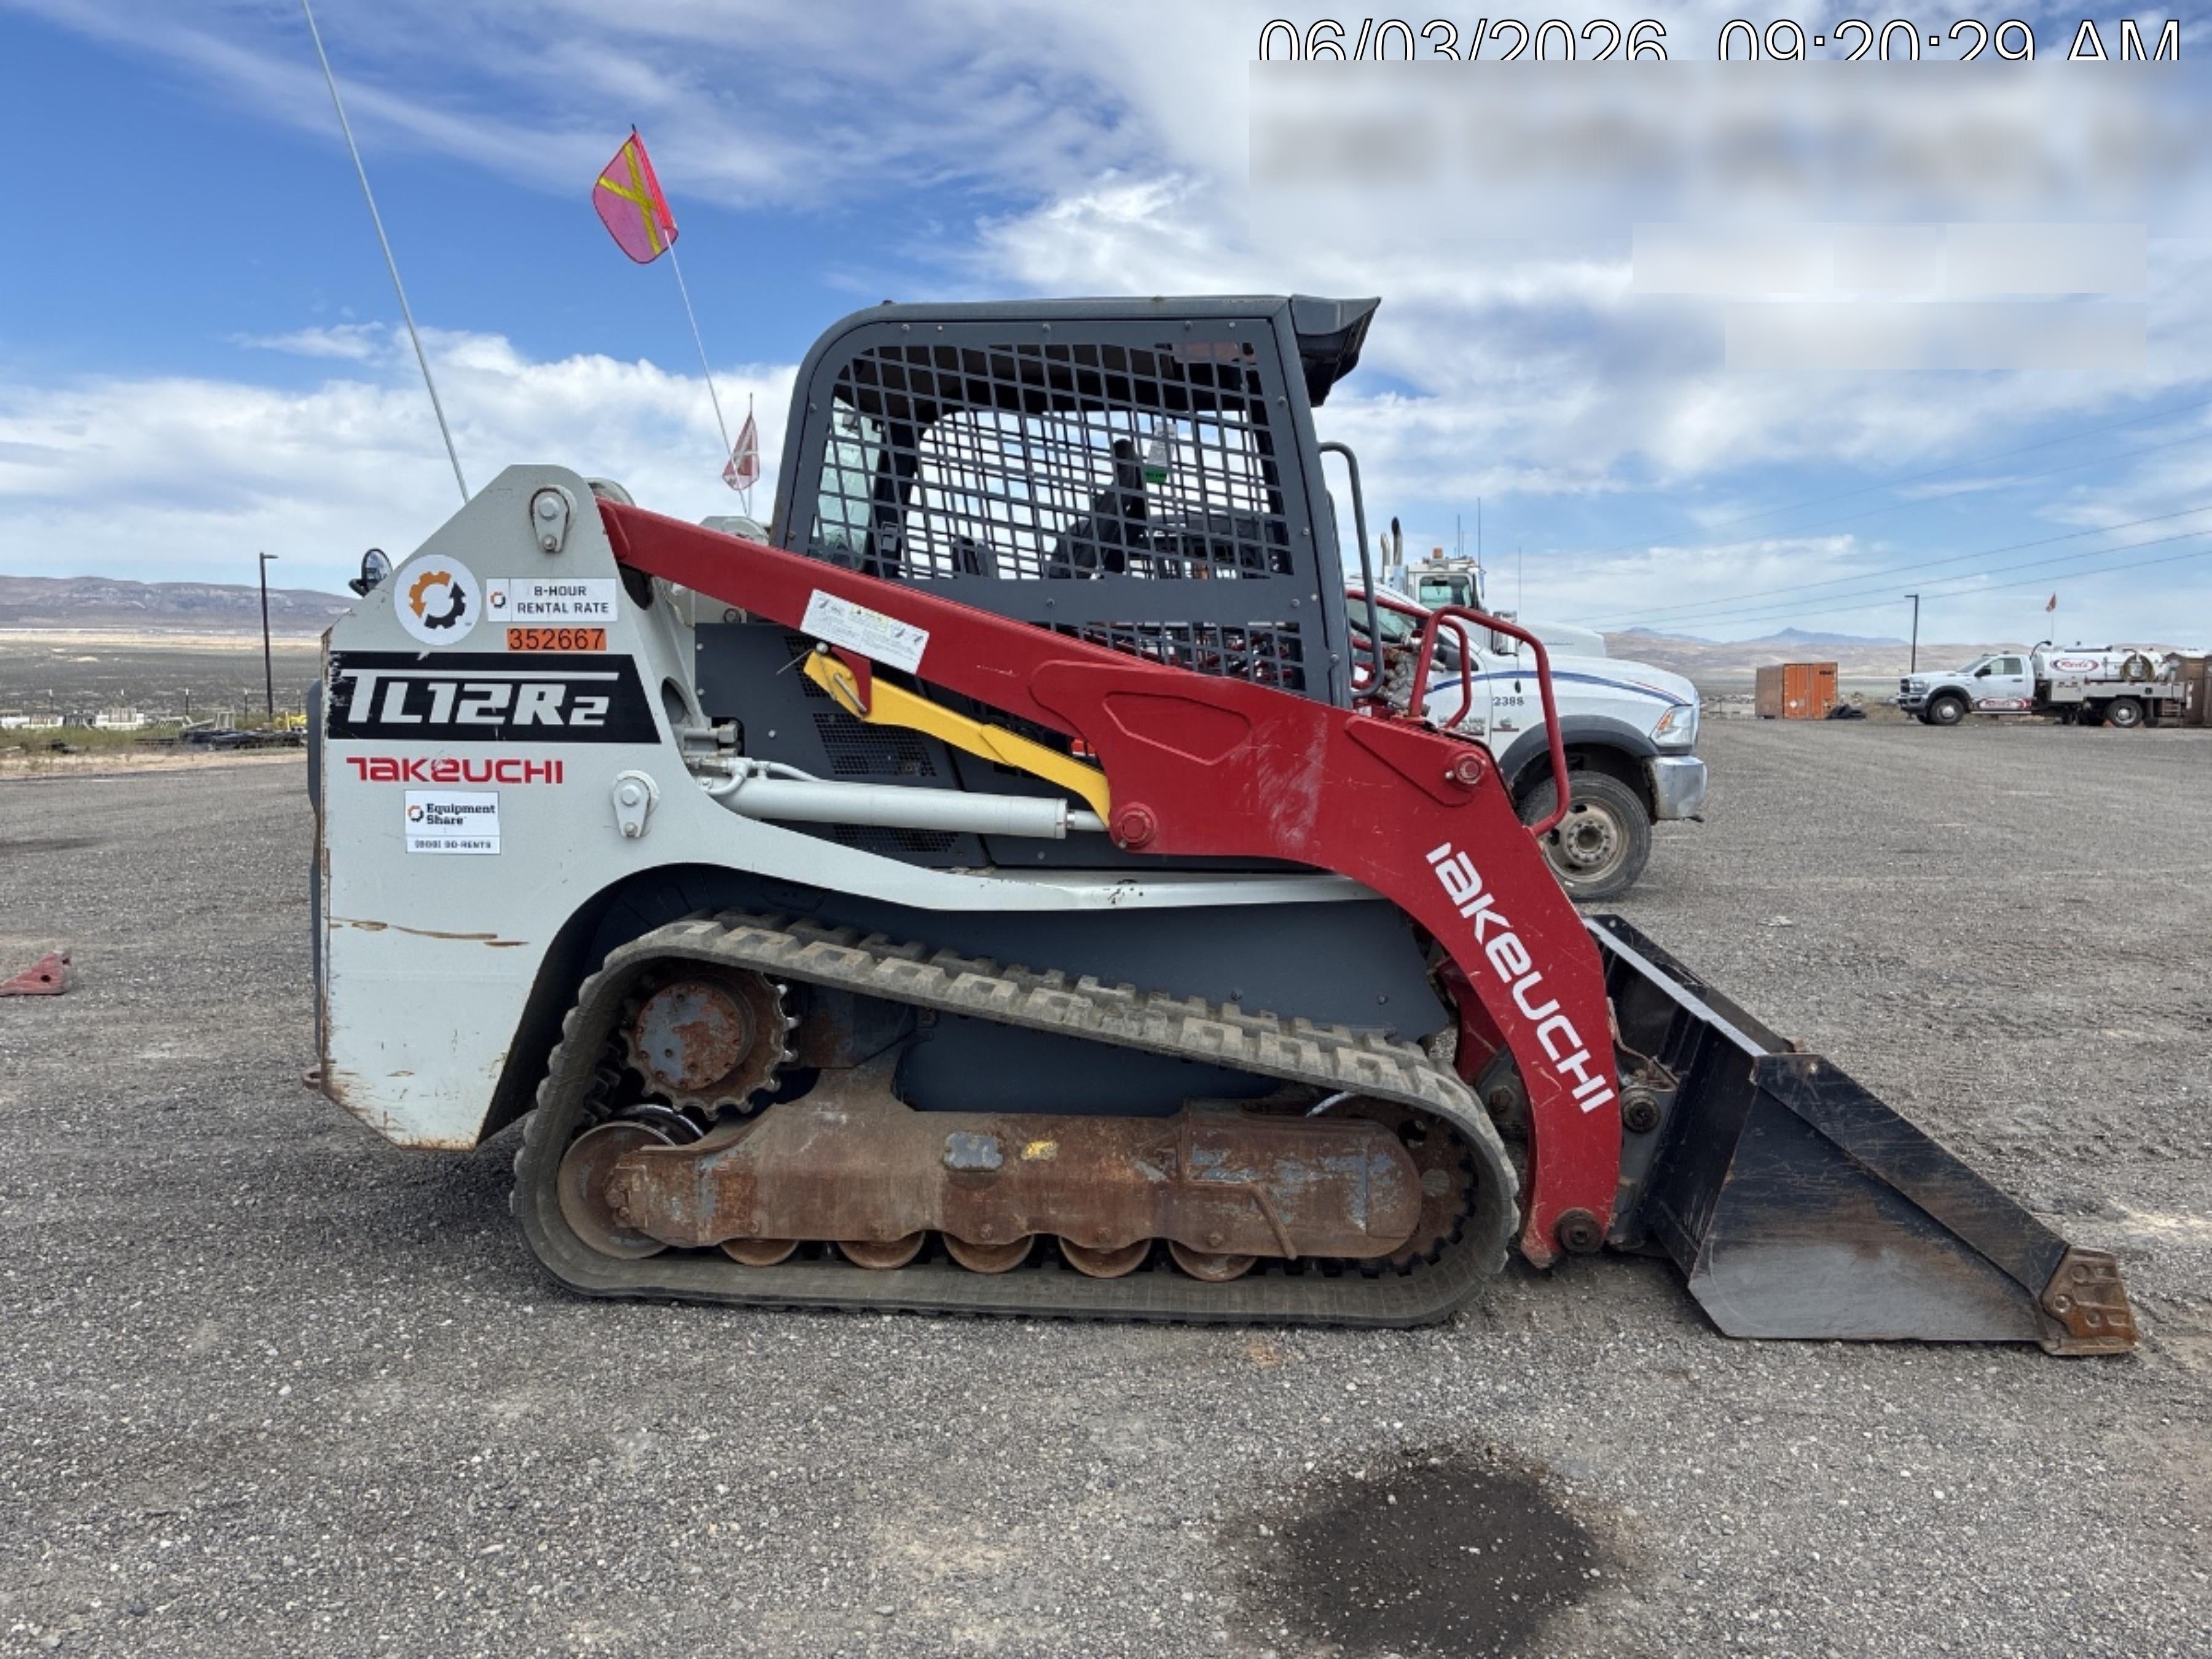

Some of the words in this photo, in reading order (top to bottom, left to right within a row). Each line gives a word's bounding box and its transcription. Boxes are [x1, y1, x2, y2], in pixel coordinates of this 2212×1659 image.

[534, 586, 587, 597] 8-HOUR
[517, 602, 570, 614] RENTAL
[574, 602, 610, 614] RATE
[509, 627, 606, 650] 352667
[340, 669, 620, 726] TL12R2
[1493, 696, 1525, 707] 2388
[345, 756, 563, 785] TAKEUCHI
[426, 803, 495, 815] Equipment
[426, 814, 464, 826] Share
